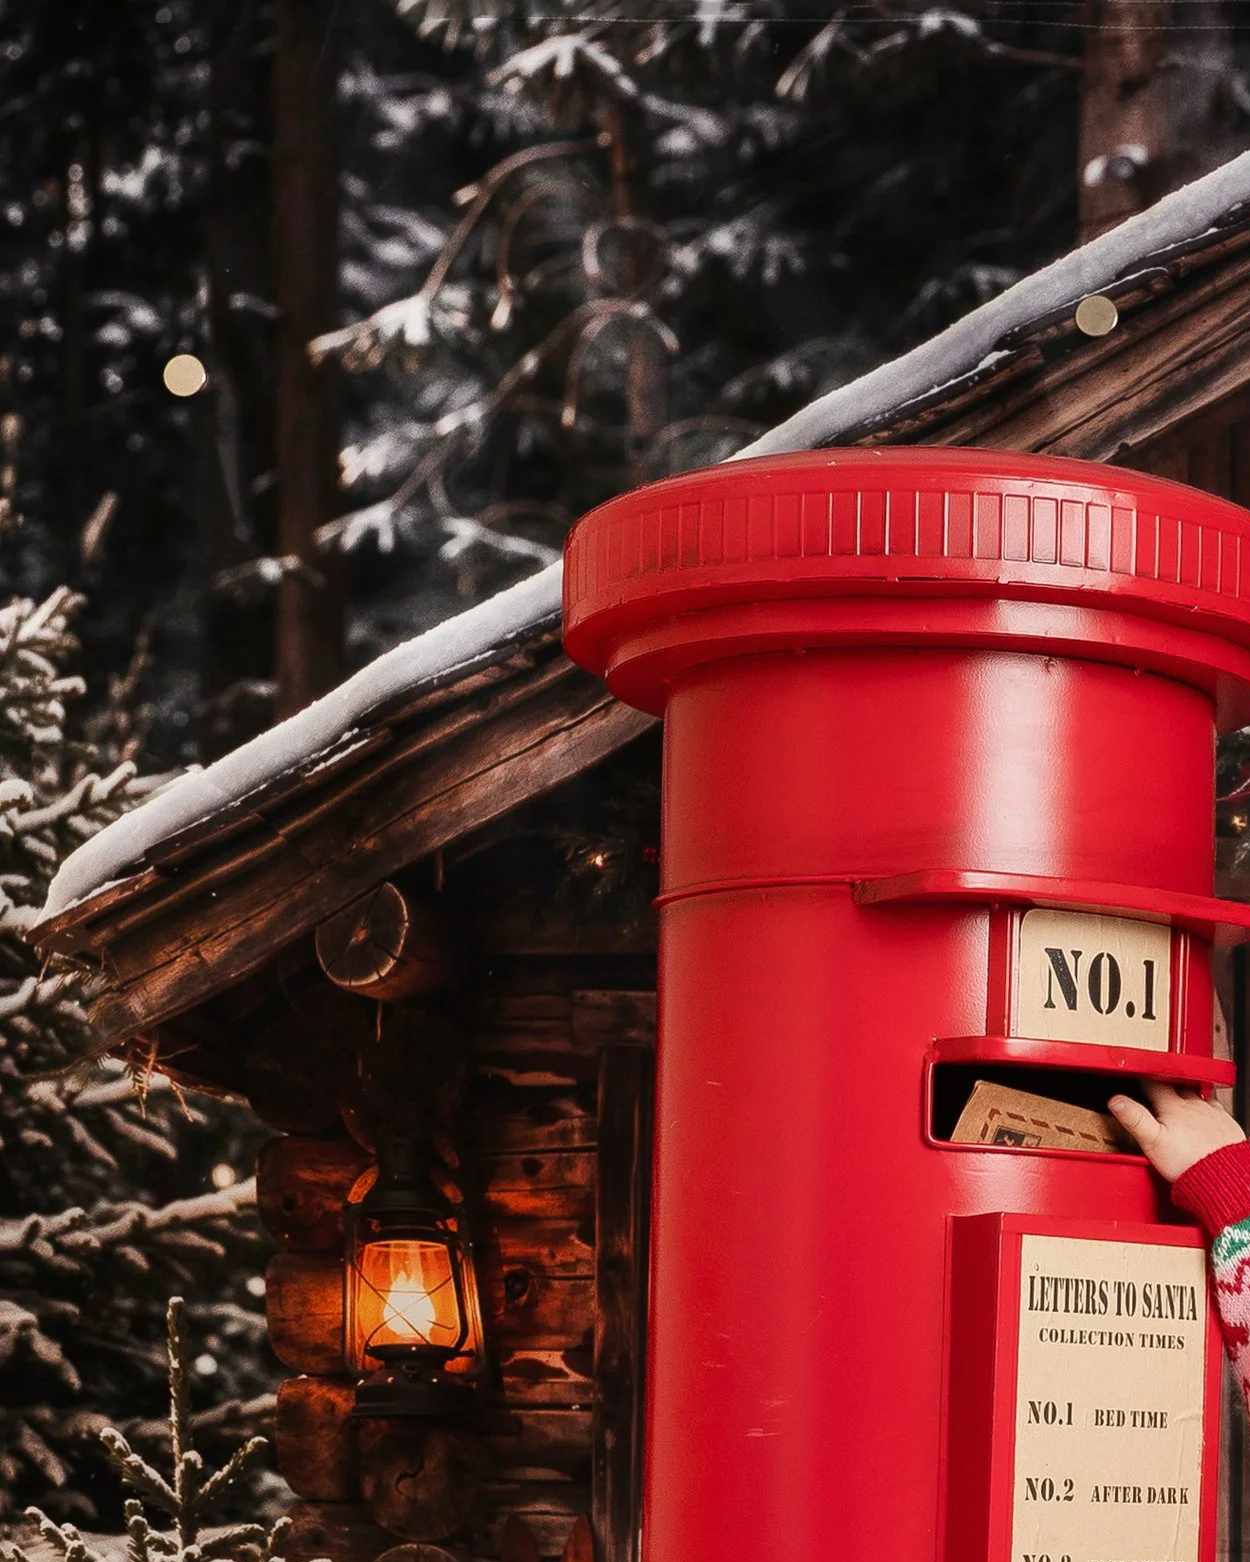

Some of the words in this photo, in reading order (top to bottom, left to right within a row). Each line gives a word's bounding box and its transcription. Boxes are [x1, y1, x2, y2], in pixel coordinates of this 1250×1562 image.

[1044, 948, 1157, 1021] NO.1
[1028, 1275, 1109, 1316] LETTERS
[1113, 1280, 1137, 1318] TO
[1142, 1282, 1198, 1321] SANTA
[1039, 1327, 1135, 1348] COLLECTION
[1139, 1332, 1186, 1351] TIMES
[1027, 1400, 1074, 1426] NO.1
[1094, 1408, 1127, 1428] BED
[1130, 1410, 1169, 1429] TIME
[1024, 1477, 1075, 1502] NO.2
[1090, 1485, 1143, 1504] AFTER
[1147, 1486, 1189, 1505] DARK
